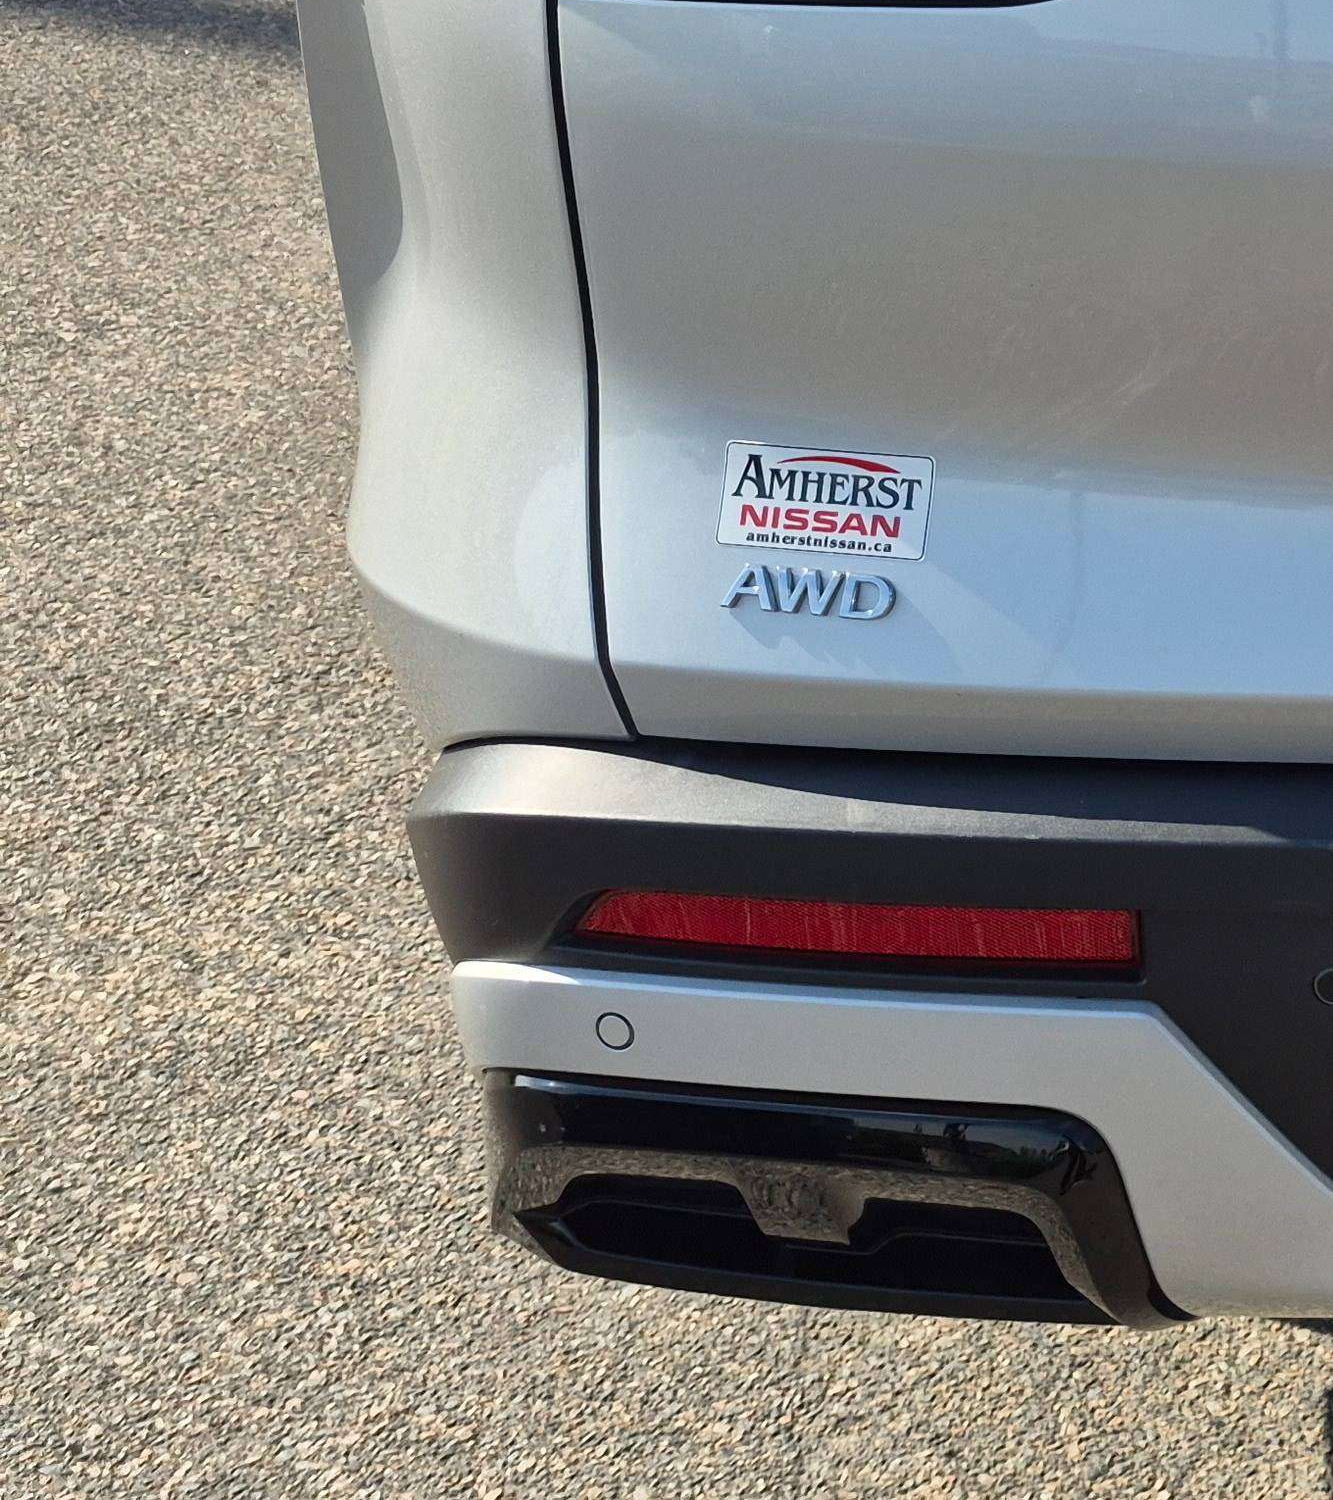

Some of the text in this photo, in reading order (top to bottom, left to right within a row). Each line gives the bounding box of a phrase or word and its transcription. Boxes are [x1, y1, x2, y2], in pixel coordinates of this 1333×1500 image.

[731, 454, 922, 510] AMHERST
[739, 504, 900, 538] NISSAN
[746, 531, 892, 553] amherstnissan.ca
[720, 563, 897, 620] AWD
